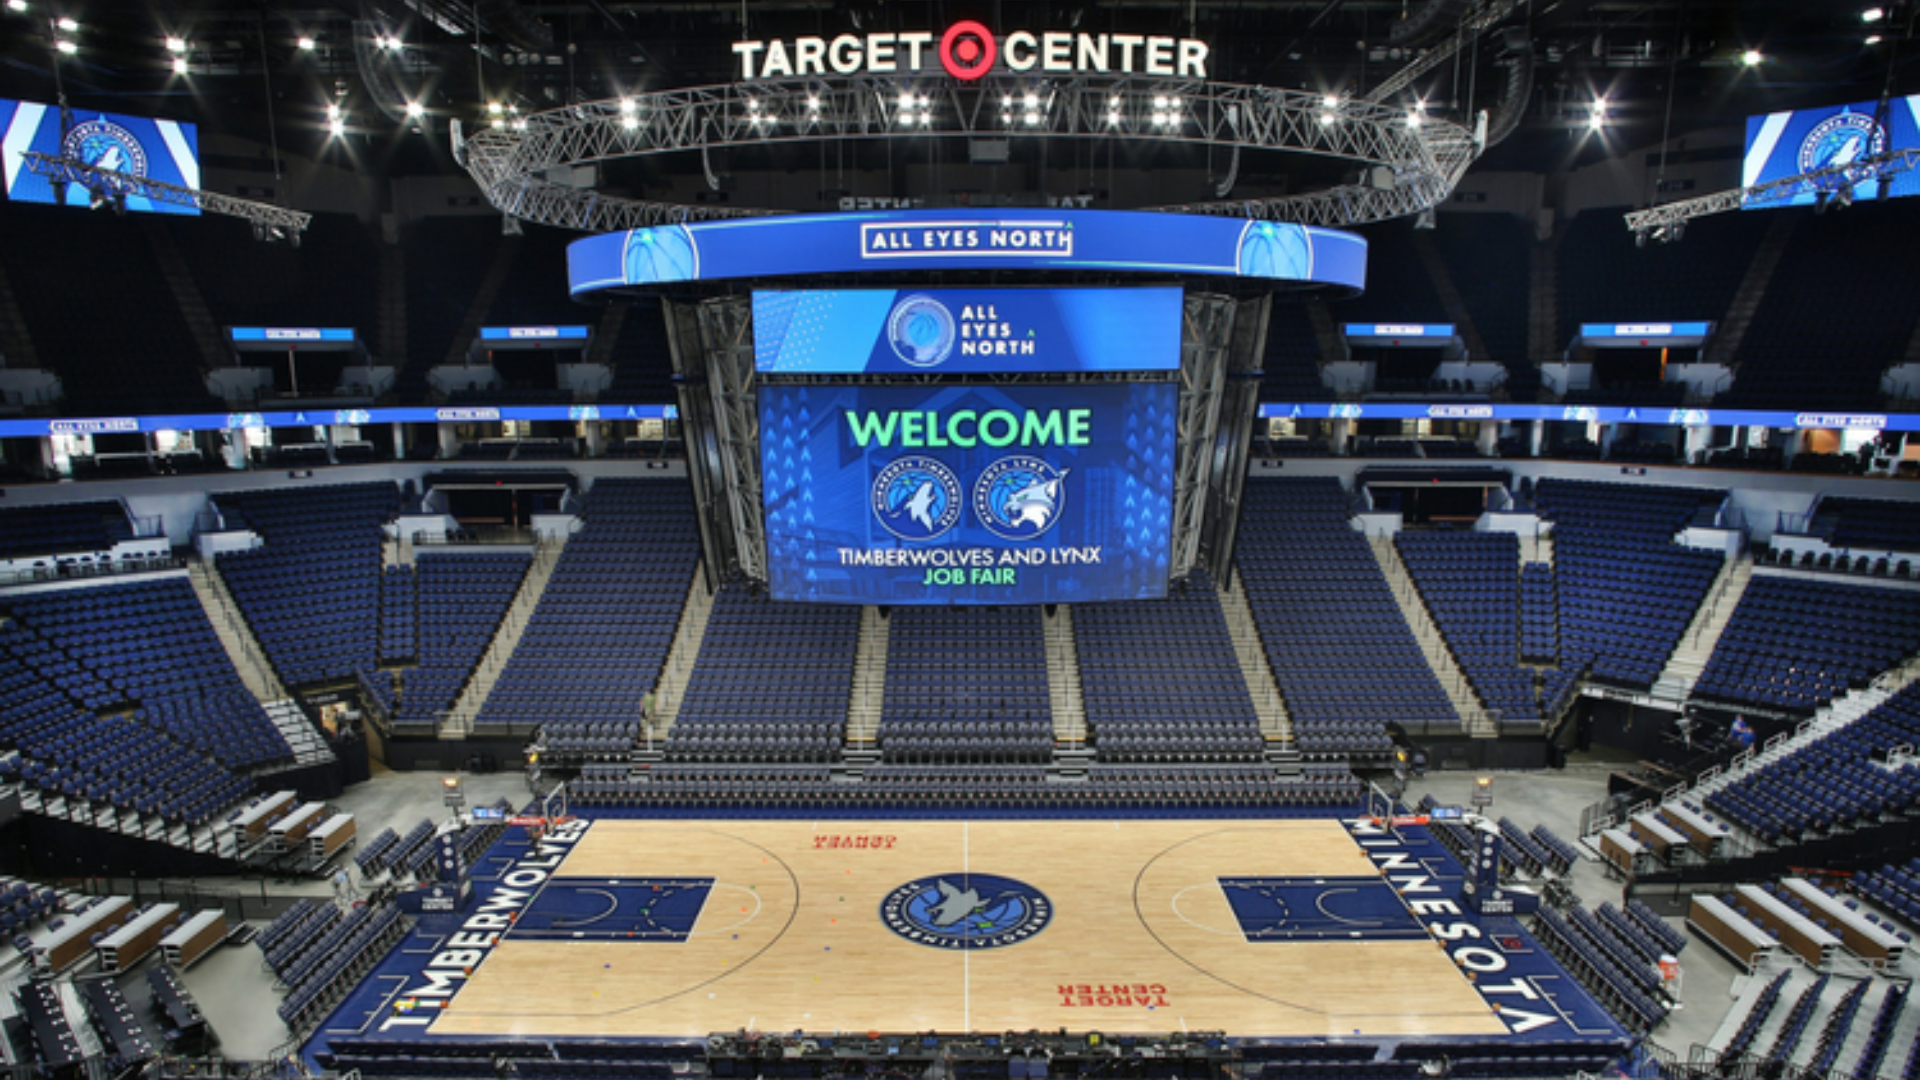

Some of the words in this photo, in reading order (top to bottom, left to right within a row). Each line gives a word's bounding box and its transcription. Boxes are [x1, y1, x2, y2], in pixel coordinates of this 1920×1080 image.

[732, 33, 932, 79] TARGET
[1004, 32, 1209, 79] CENTER
[872, 231, 912, 249] ALL
[923, 230, 979, 247] EYES
[990, 230, 1072, 247] NORTH
[960, 305, 998, 320] ALL
[961, 322, 1011, 337] EYES
[961, 340, 1035, 355] NORTH
[845, 408, 1092, 447] WELCOME
[838, 547, 994, 566] TIMBERWOLVES
[998, 548, 1046, 565] AND
[1051, 546, 1102, 564] LYNX
[923, 568, 966, 585] JOB
[970, 568, 1017, 585] FAIR
[379, 818, 590, 1032] TIMBERWOLVES
[1341, 818, 1559, 1034] MINNESOTA
[1057, 984, 1167, 995] CENTER
[1059, 995, 1171, 1007] TARGET
